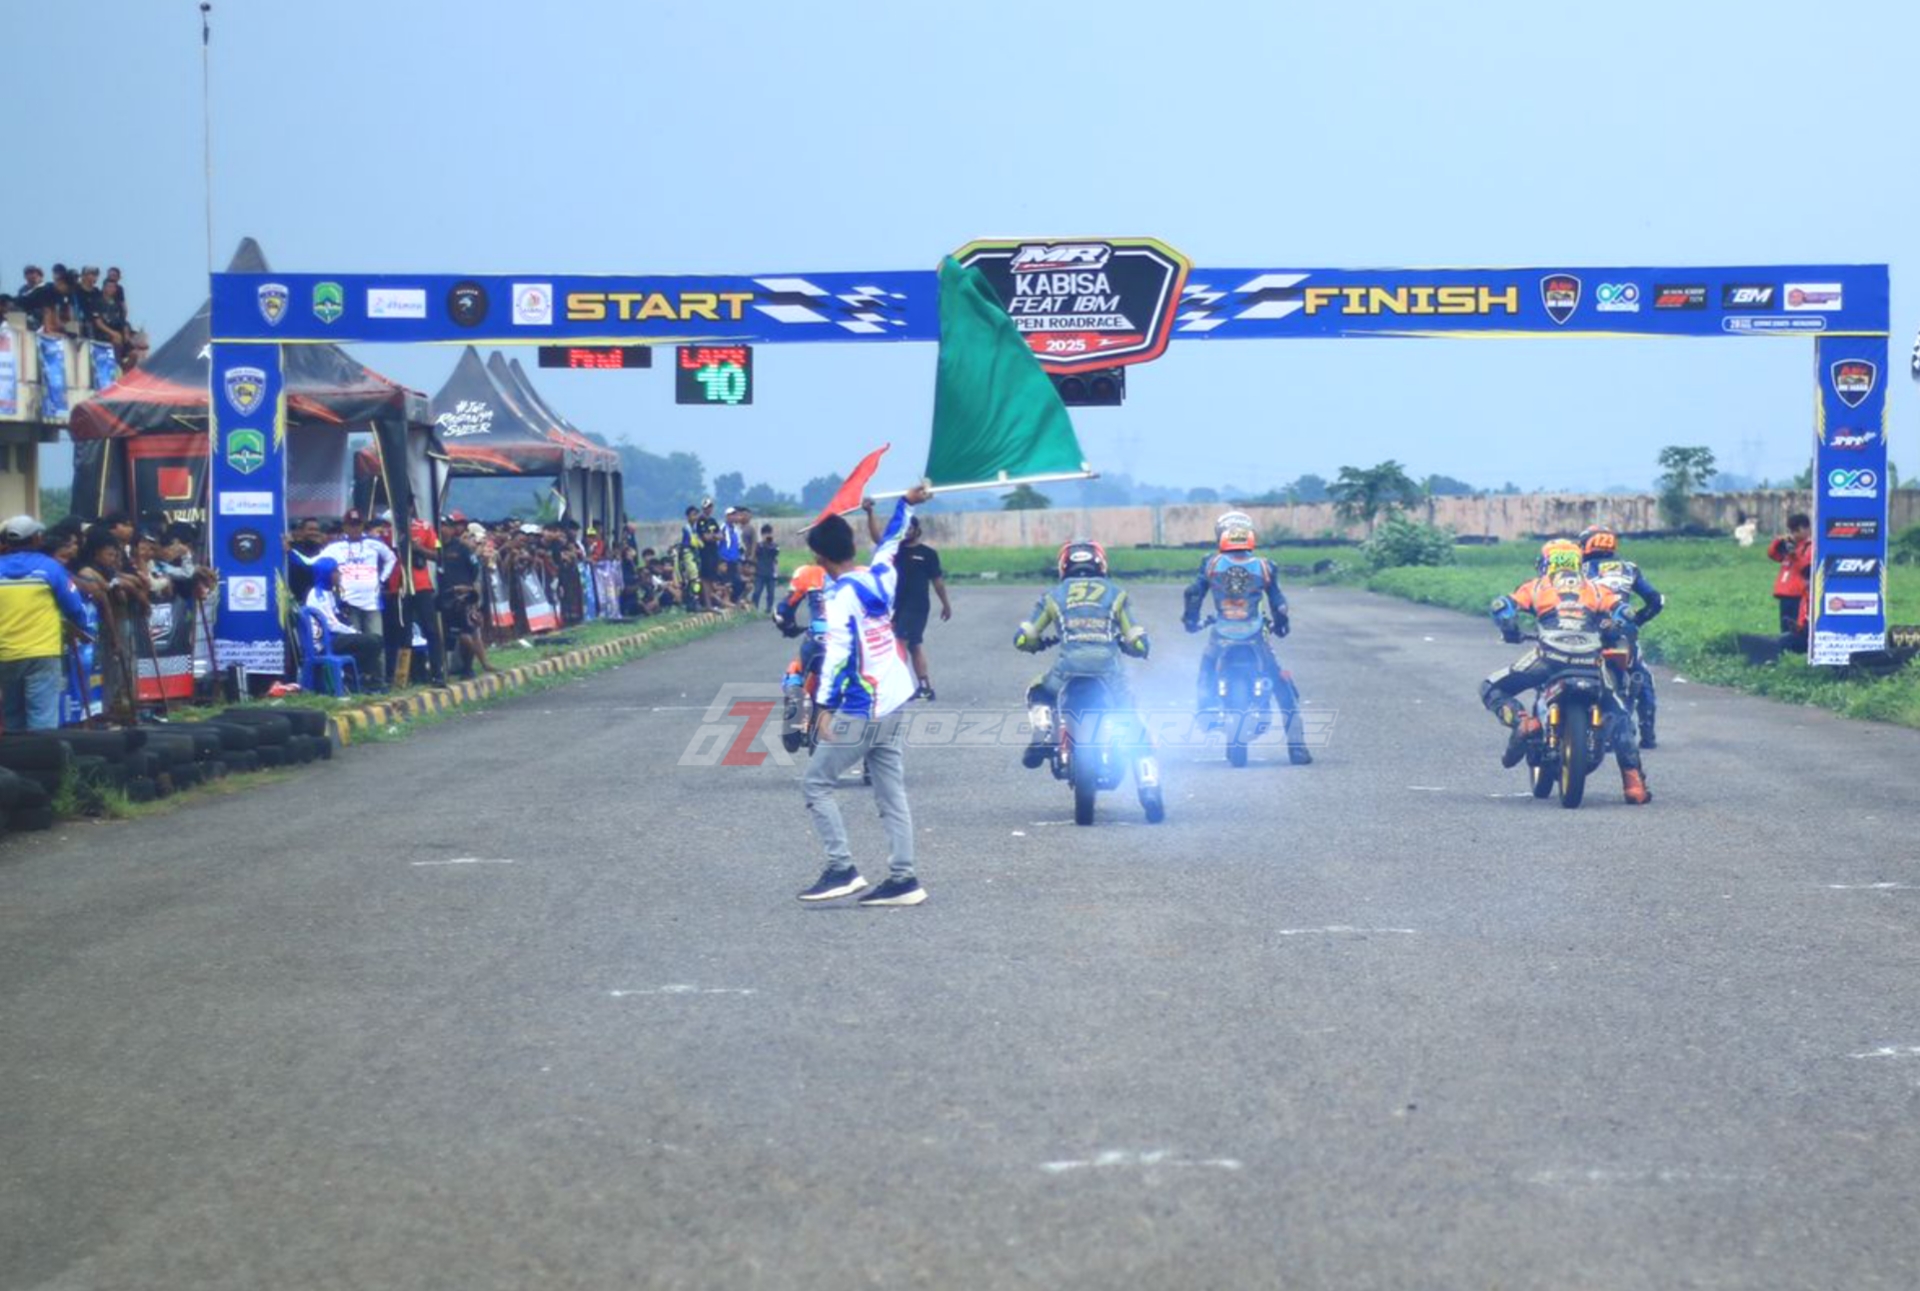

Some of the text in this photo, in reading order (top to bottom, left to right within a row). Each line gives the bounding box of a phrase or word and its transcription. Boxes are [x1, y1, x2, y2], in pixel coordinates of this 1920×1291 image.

[1015, 271, 1112, 297] KABISA
[566, 292, 754, 321] START
[1008, 294, 1121, 314] FEAT IBM
[1304, 286, 1519, 315] FINISH
[1012, 315, 1123, 330] PEN ROADRACE
[1046, 338, 1086, 352] 2025
[1066, 581, 1106, 604] 57
